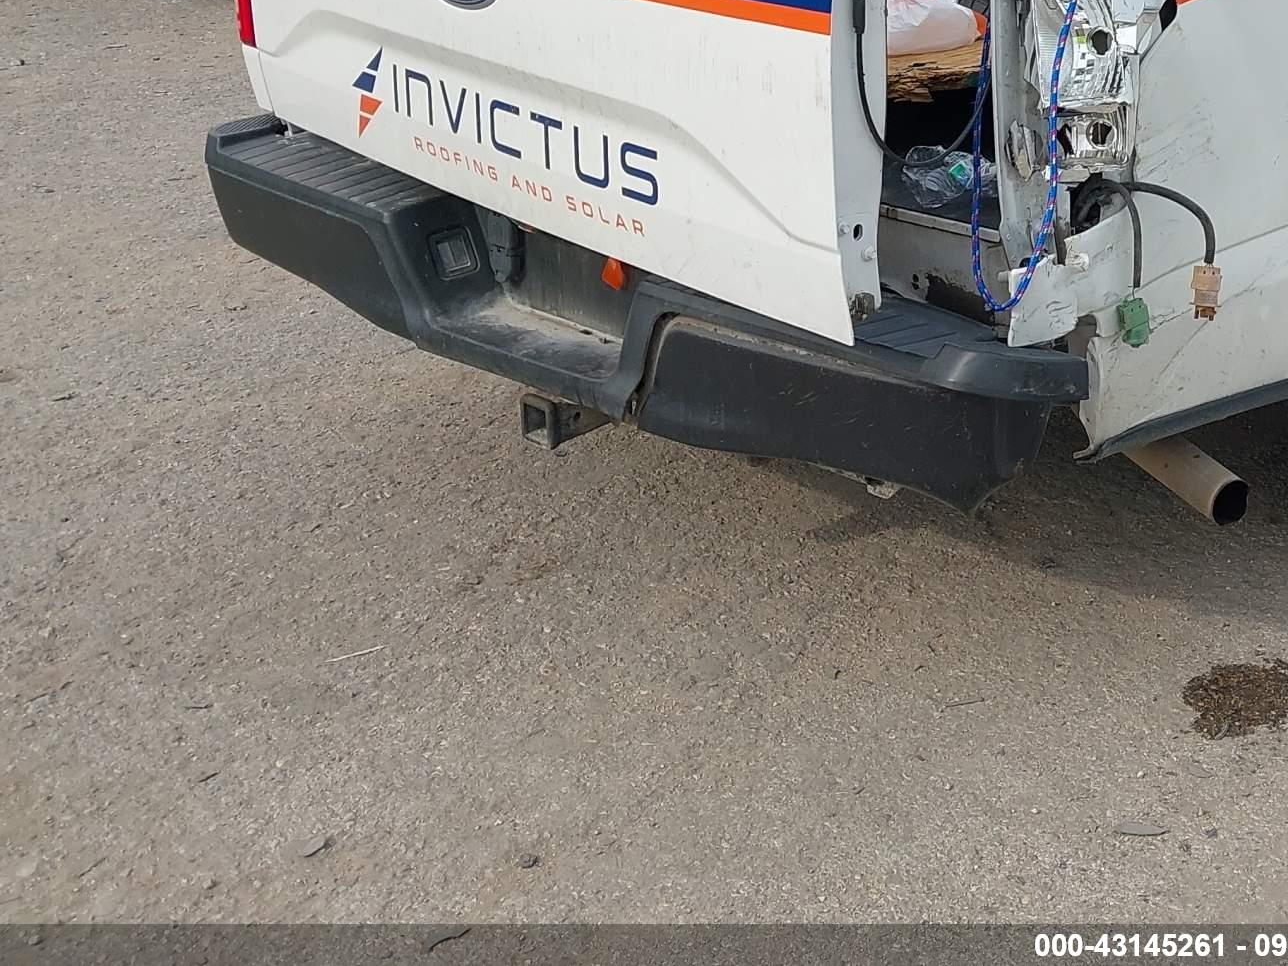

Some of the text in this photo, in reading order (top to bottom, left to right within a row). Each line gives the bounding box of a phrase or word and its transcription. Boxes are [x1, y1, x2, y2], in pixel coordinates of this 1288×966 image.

[392, 64, 659, 206] INVICTUS
[414, 136, 646, 238] ROOFING AND SOLAR
